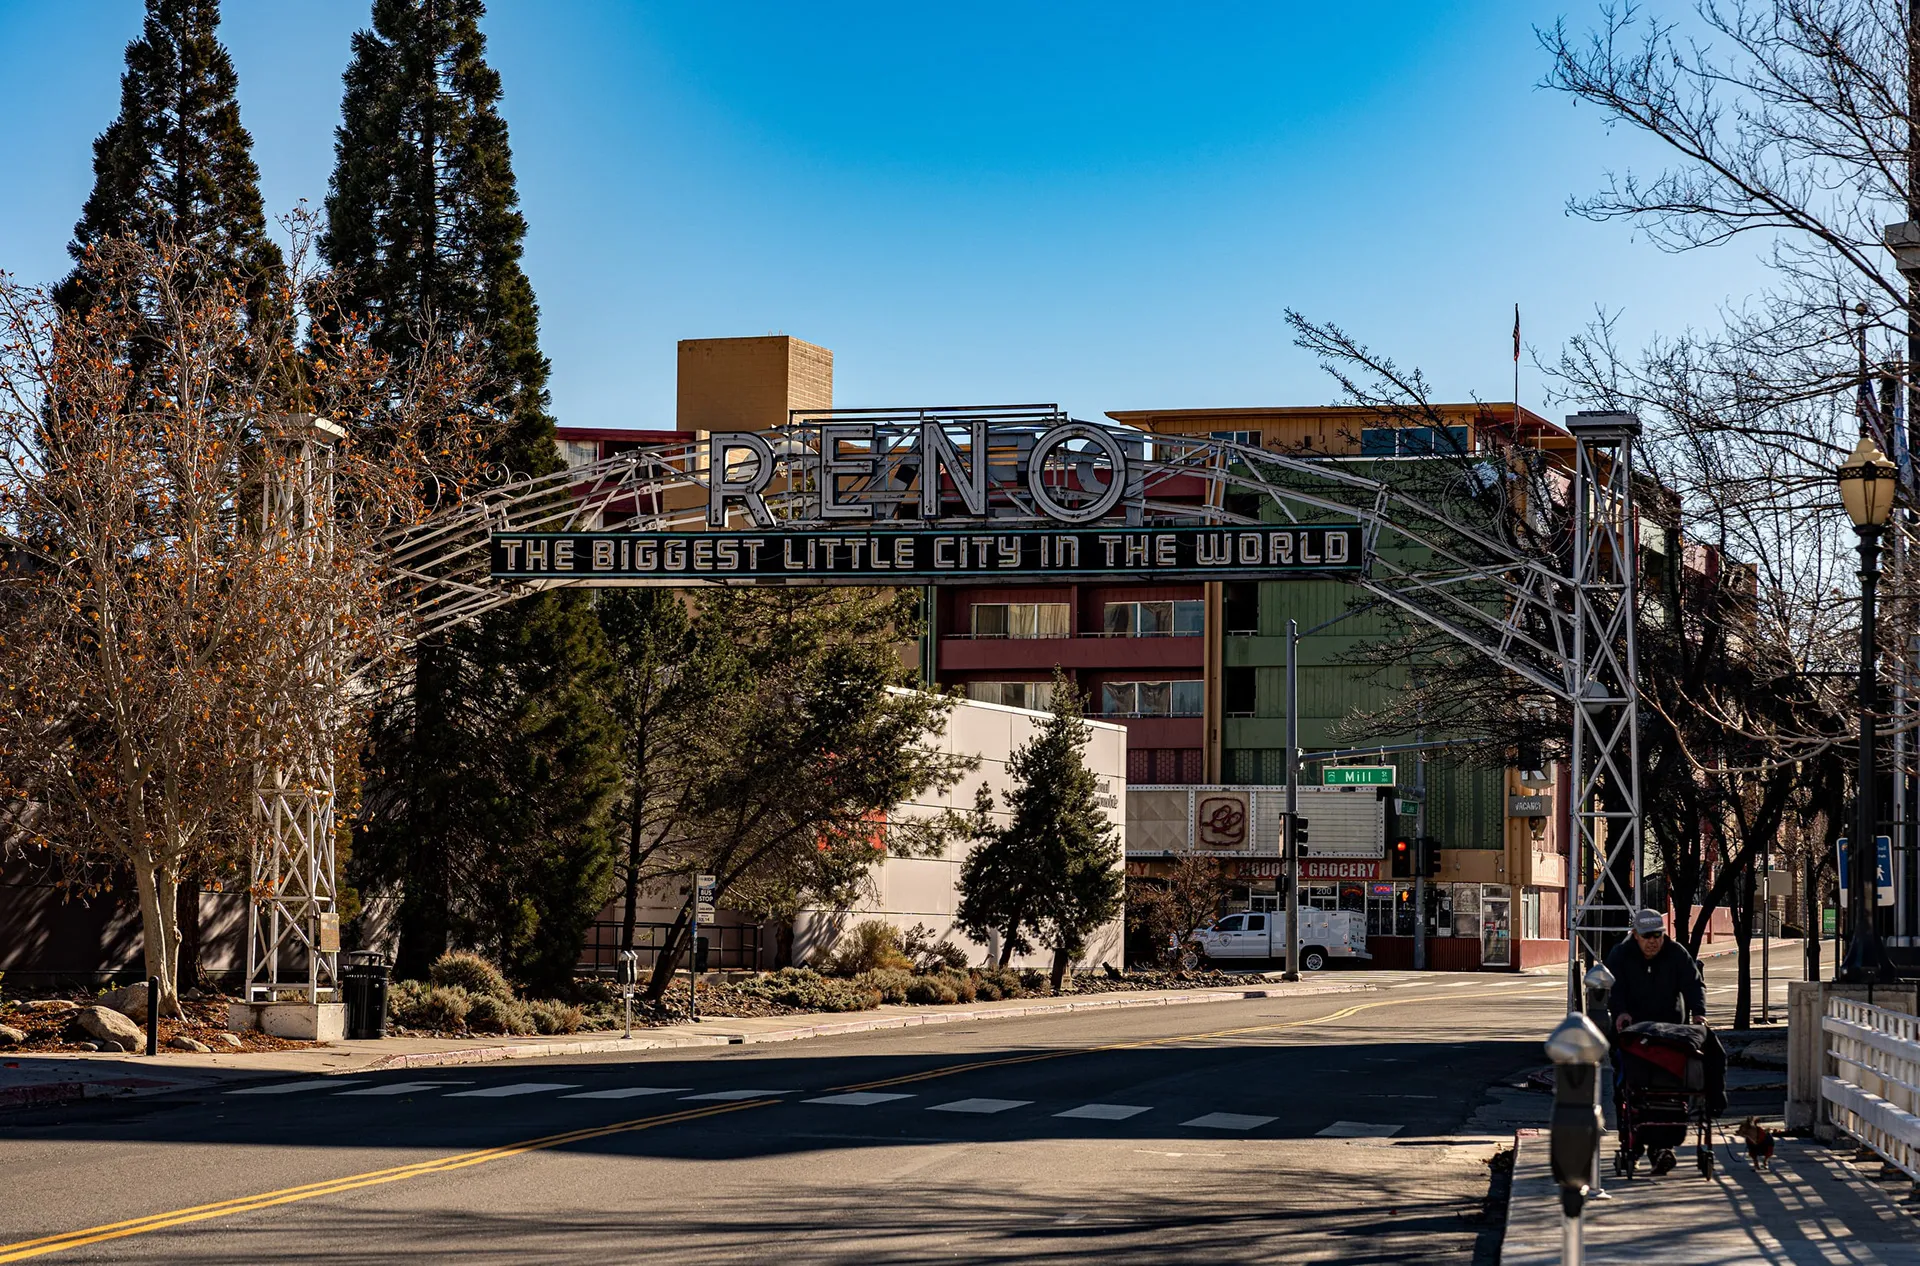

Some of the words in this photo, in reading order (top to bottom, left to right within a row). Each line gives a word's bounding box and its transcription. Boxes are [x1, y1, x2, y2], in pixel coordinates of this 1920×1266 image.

[708, 418, 1128, 528] RENO
[500, 538, 575, 571] THE
[592, 537, 765, 571] BIGGEST
[784, 537, 915, 570] LITTLE
[934, 536, 1022, 569] CITY
[1098, 534, 1177, 567] THE
[1197, 531, 1349, 565] WORLD
[1345, 771, 1371, 782] Mill
[1515, 801, 1541, 811] VACANCY
[1308, 862, 1376, 877] GROCERY
